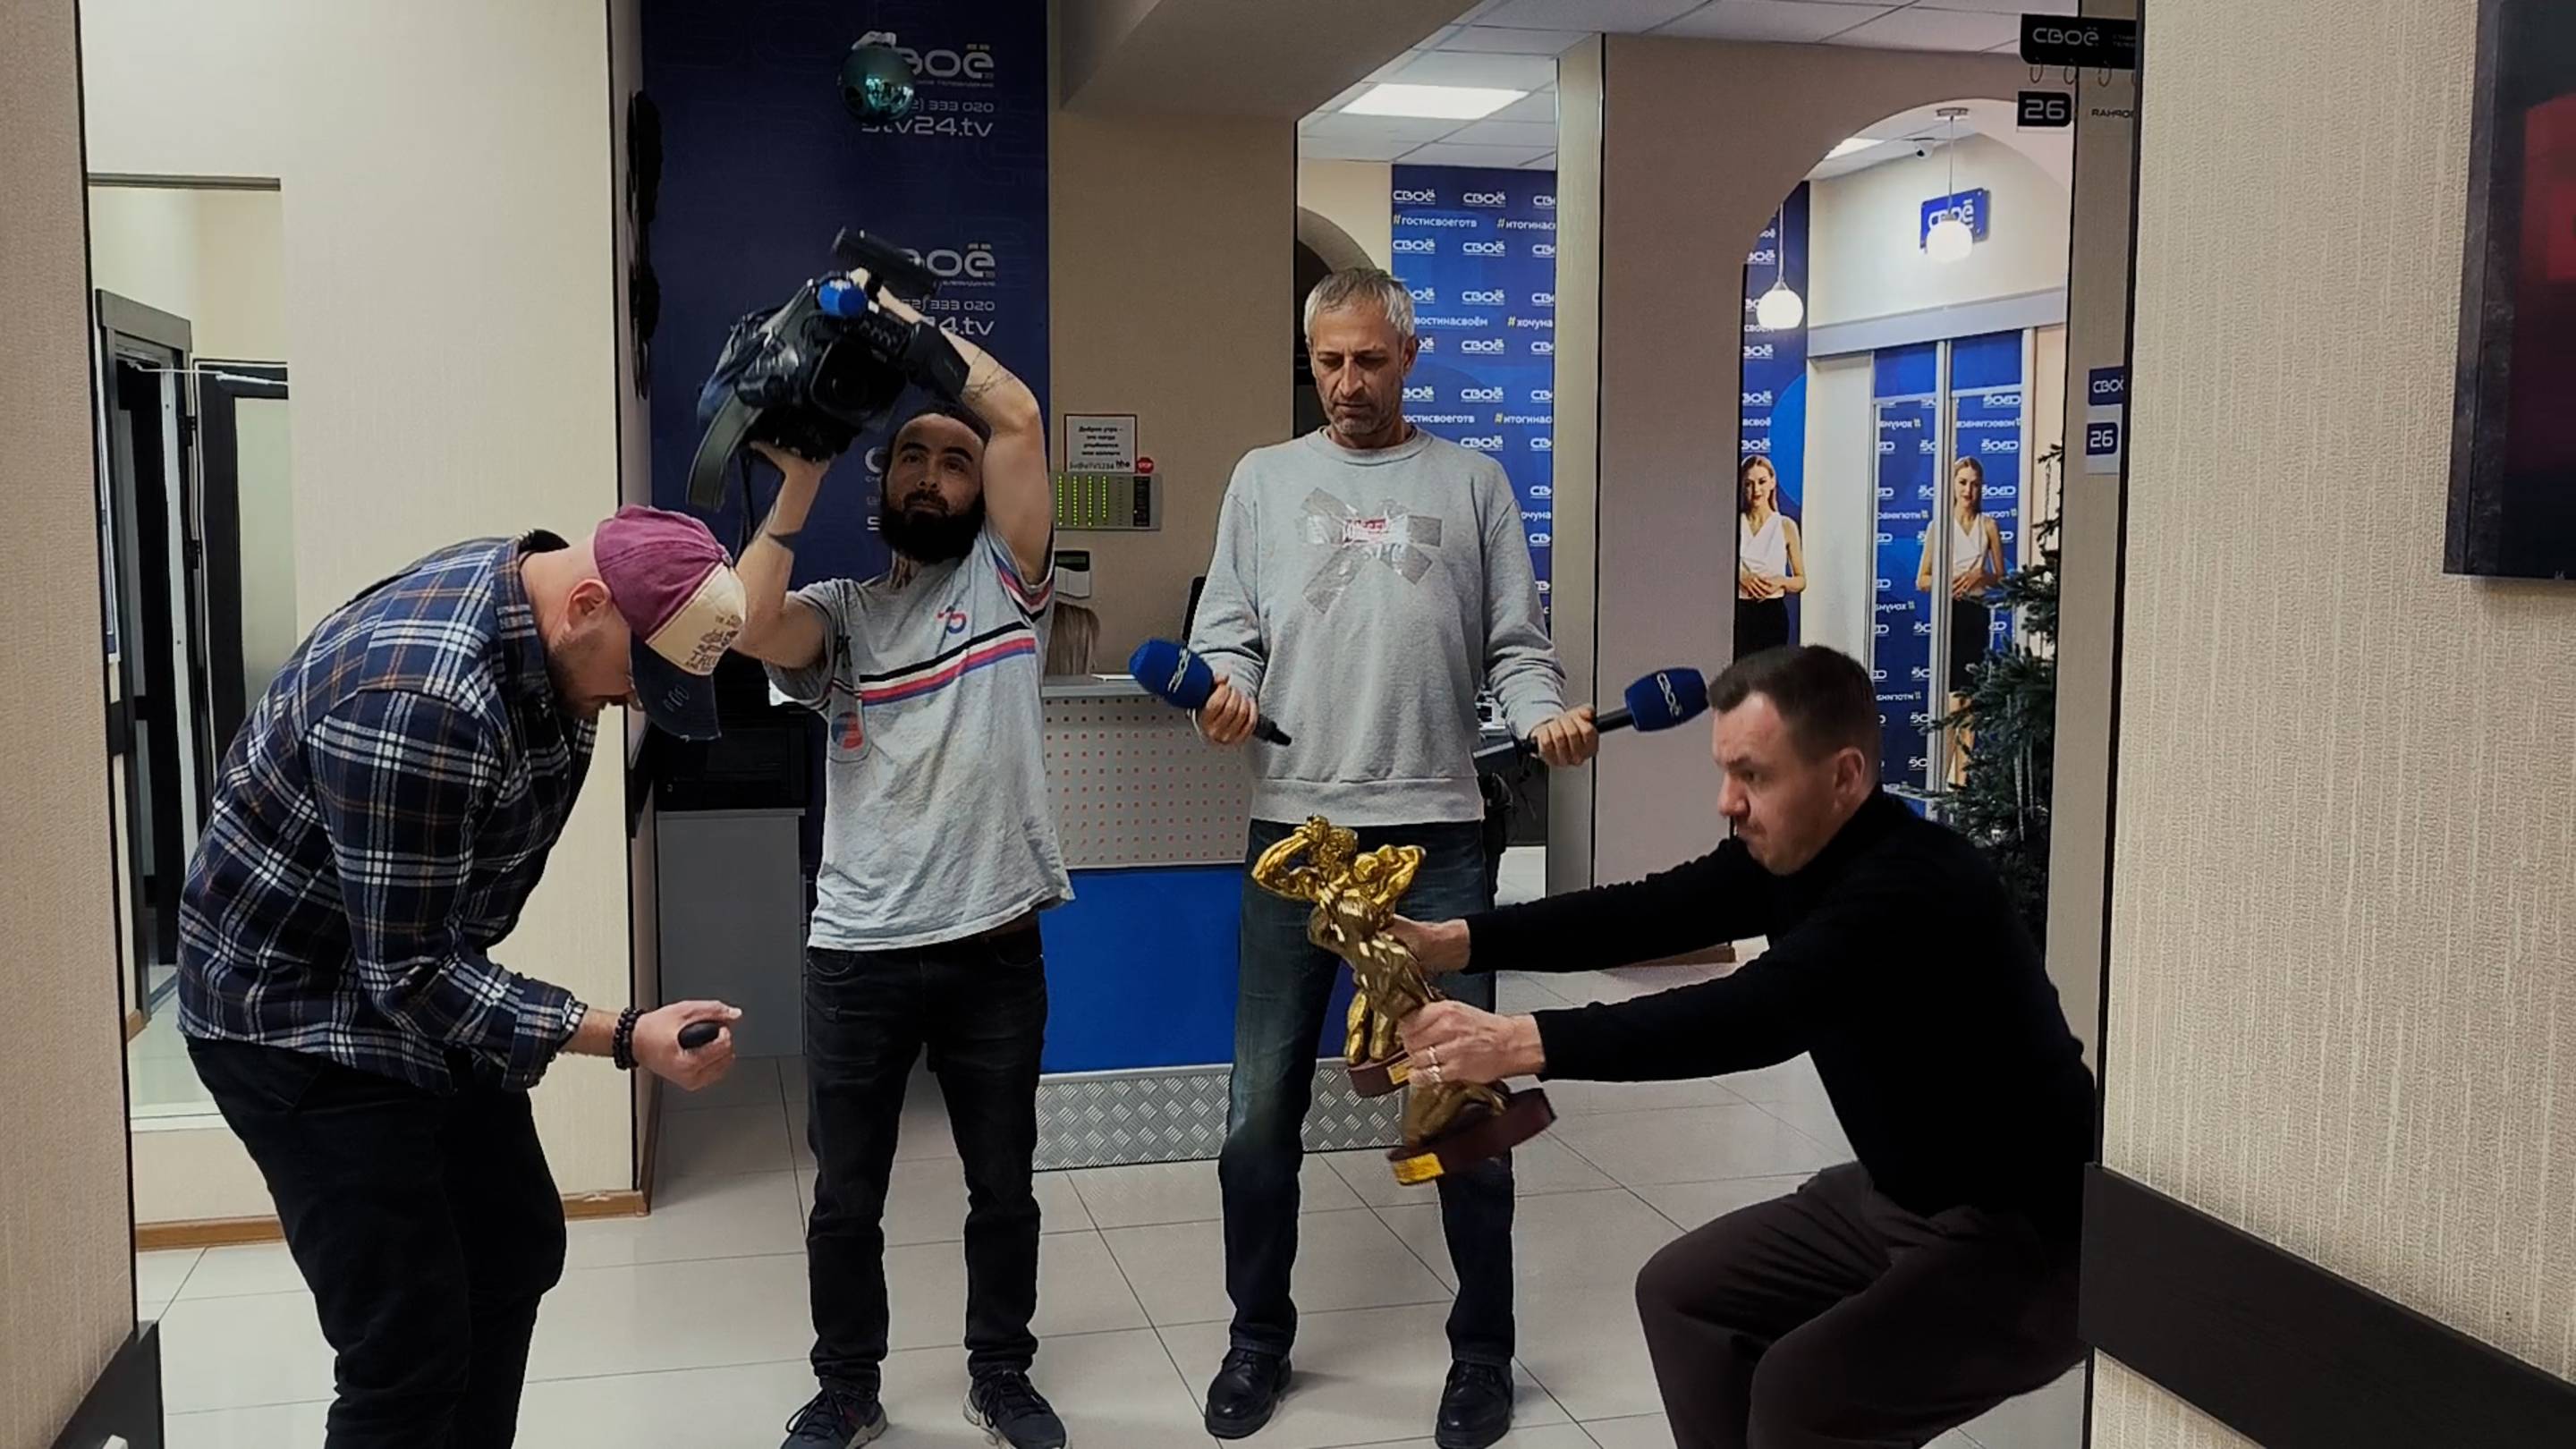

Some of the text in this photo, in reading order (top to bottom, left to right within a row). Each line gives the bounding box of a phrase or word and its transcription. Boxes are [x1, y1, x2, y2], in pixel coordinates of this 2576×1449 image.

[928, 99, 959, 113] 333
[962, 101, 995, 114] 020
[2024, 99, 2065, 120] 26
[930, 300, 960, 310] 333
[963, 301, 996, 311] 020
[2089, 430, 2114, 448] 26
